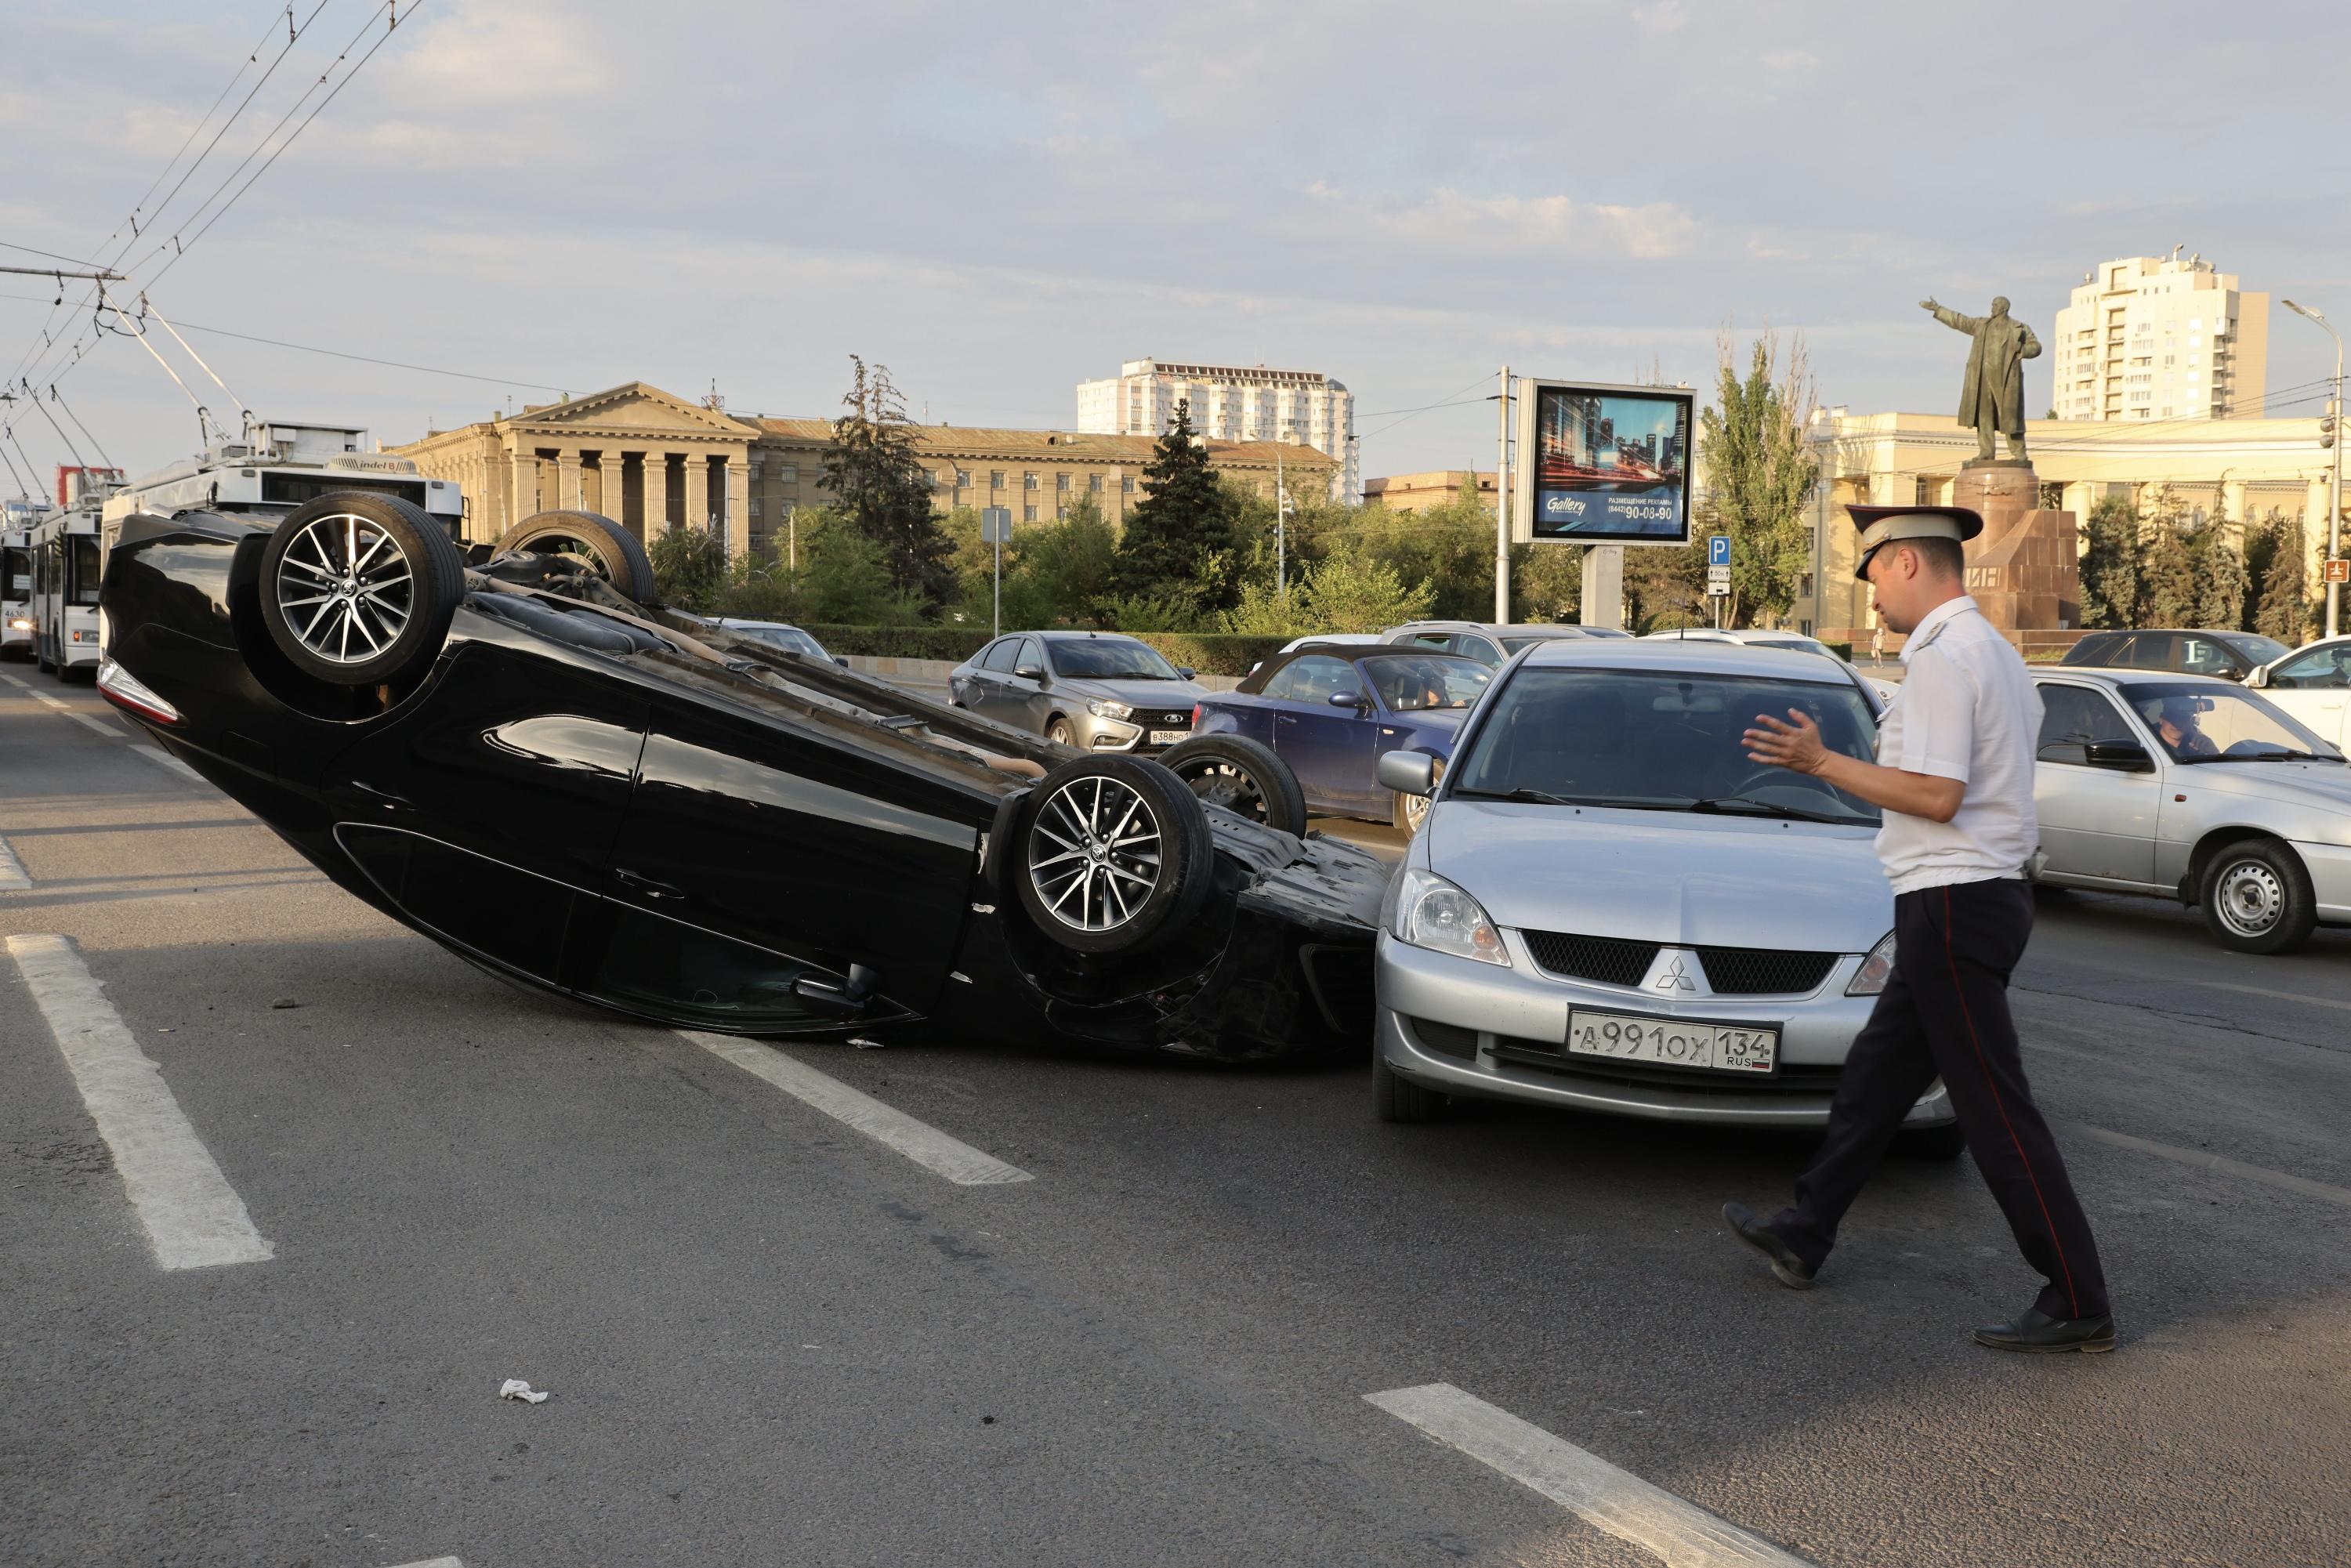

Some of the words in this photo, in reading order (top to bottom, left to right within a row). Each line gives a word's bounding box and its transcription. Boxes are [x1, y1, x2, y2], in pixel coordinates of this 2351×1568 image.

[360, 460, 386, 469] indel
[1547, 497, 1586, 516] Gallery
[1608, 505, 1626, 514] (8442)
[1626, 506, 1672, 520] 90-08-90
[1714, 540, 1726, 563] P
[1717, 1030, 1766, 1058] 134
[1727, 1056, 1751, 1067] RUS
